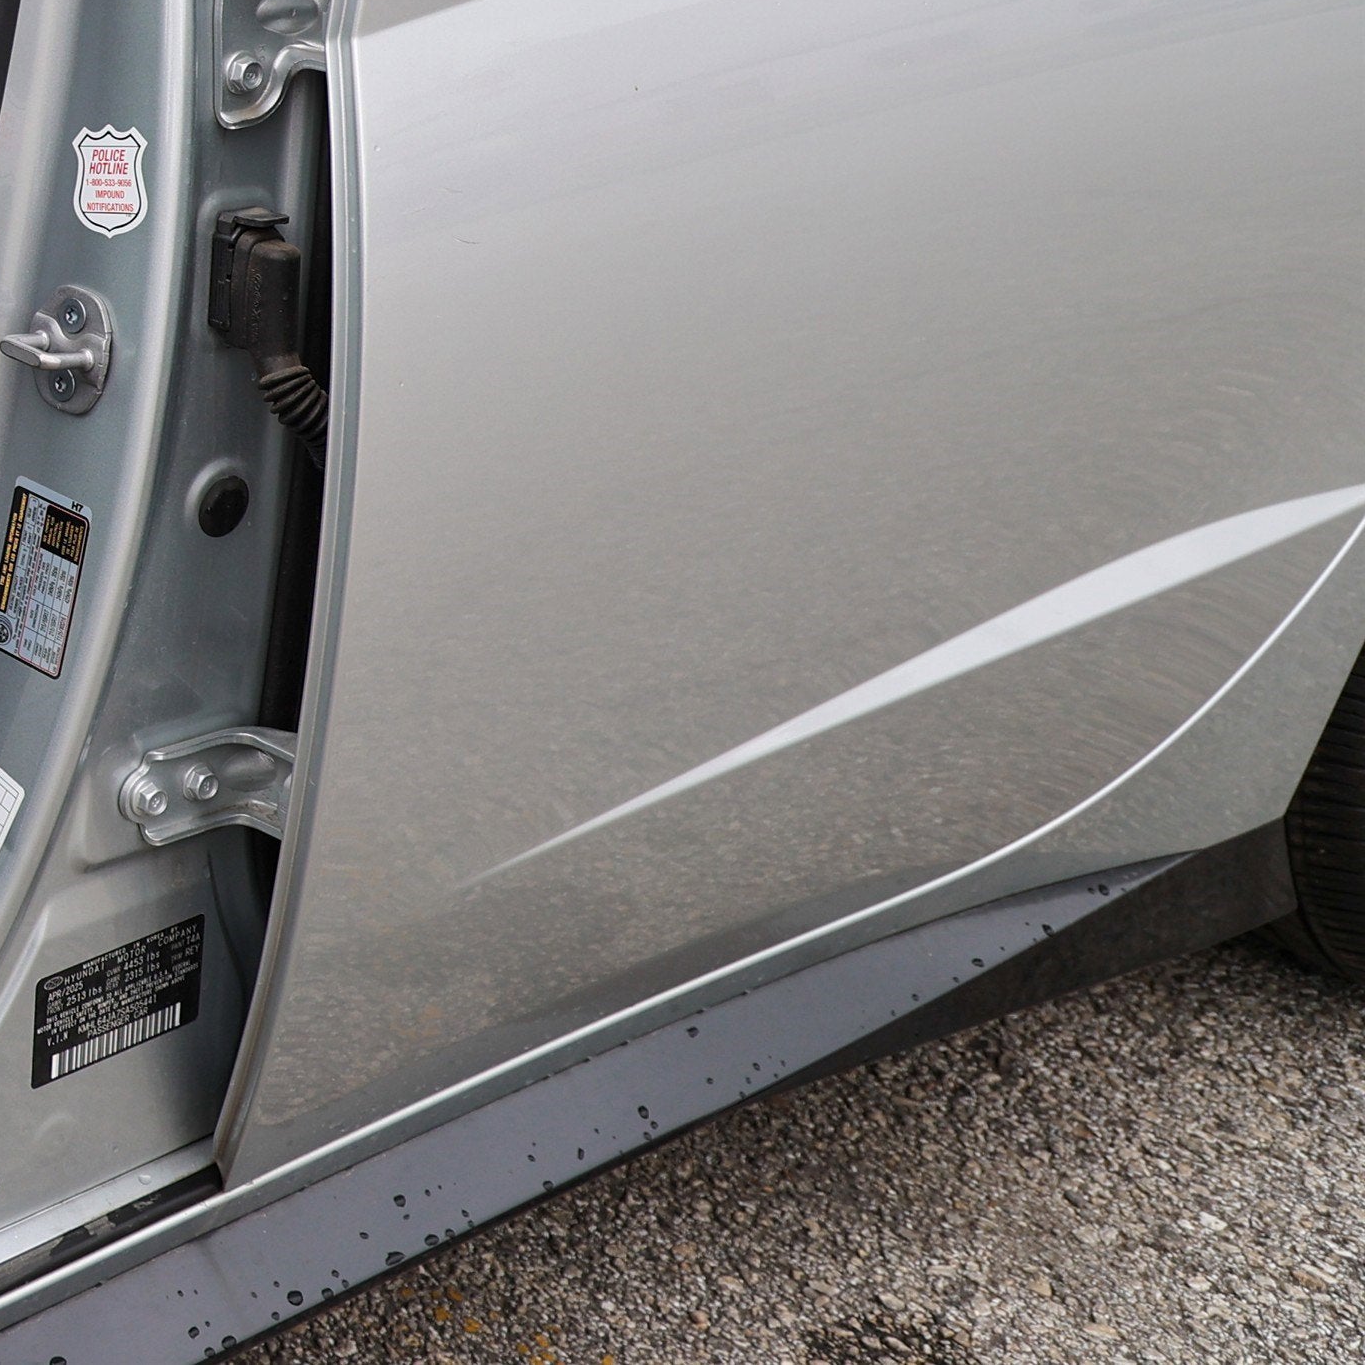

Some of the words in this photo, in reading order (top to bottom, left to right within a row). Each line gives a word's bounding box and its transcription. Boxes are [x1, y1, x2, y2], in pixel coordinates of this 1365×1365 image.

[92, 149, 125, 162] POLICE
[89, 162, 129, 175] HOTLINE
[86, 178, 132, 187] 1-800-533-9056
[95, 190, 125, 199] IMPOUND
[86, 203, 134, 212] NOTIFICATIONS
[71, 501, 85, 513] H7
[64, 962, 104, 985] HYUNDAI
[116, 944, 146, 963] MOTOR
[157, 924, 196, 947] COMPANY
[47, 980, 83, 1002] APR/2025
[123, 954, 143, 971] 4453
[146, 948, 160, 962] lbs
[66, 990, 86, 1007] 2513
[88, 983, 102, 997] lbs
[124, 966, 143, 983] 2315
[146, 959, 160, 973] lbs
[184, 943, 199, 957] REY
[87, 1013, 130, 1038] PASSENGER
[133, 1005, 148, 1019] CAR
